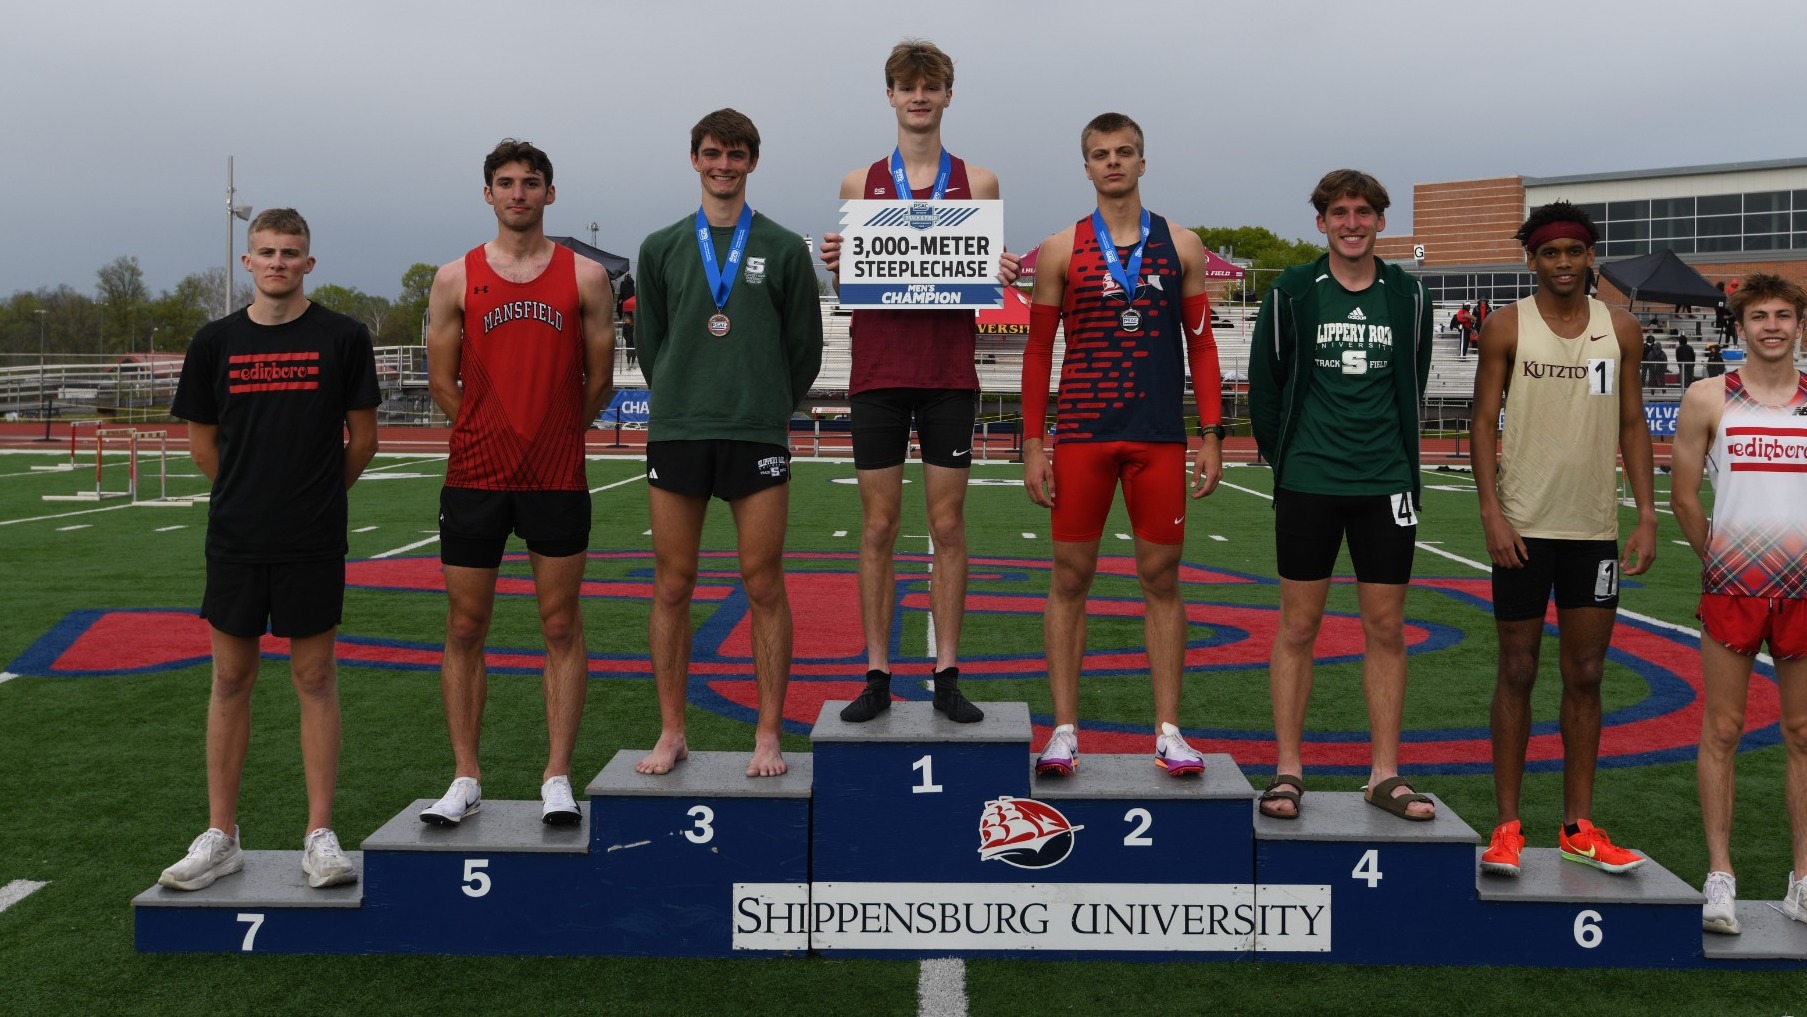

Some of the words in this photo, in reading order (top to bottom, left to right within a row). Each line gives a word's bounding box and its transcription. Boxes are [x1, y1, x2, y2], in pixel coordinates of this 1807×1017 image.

[853, 236, 989, 258] 3,000-METER
[1415, 246, 1424, 258] G
[854, 260, 987, 277] STEEPLECHASE
[881, 292, 962, 304] CHAMPION
[908, 284, 935, 292] MEN'S
[483, 301, 563, 333] MANSFIELD
[241, 363, 308, 381] edinboro
[1315, 359, 1340, 368] TRACK
[1342, 350, 1367, 374] S
[1523, 361, 1588, 379] KUTZTO
[1595, 361, 1606, 394] 1
[621, 400, 650, 414] CHA
[1646, 420, 1663, 431] IC
[1398, 493, 1412, 524] 4
[1605, 562, 1614, 594] 1
[912, 755, 943, 793] 1
[684, 806, 714, 843] 3
[1123, 808, 1153, 846] 2
[461, 859, 491, 897] 5
[1351, 850, 1383, 887] 4
[737, 897, 1049, 934] SHIPPENSBURG
[1072, 903, 1325, 936] UNIVERSITY
[1573, 910, 1603, 949] 6
[236, 914, 264, 951] 7
